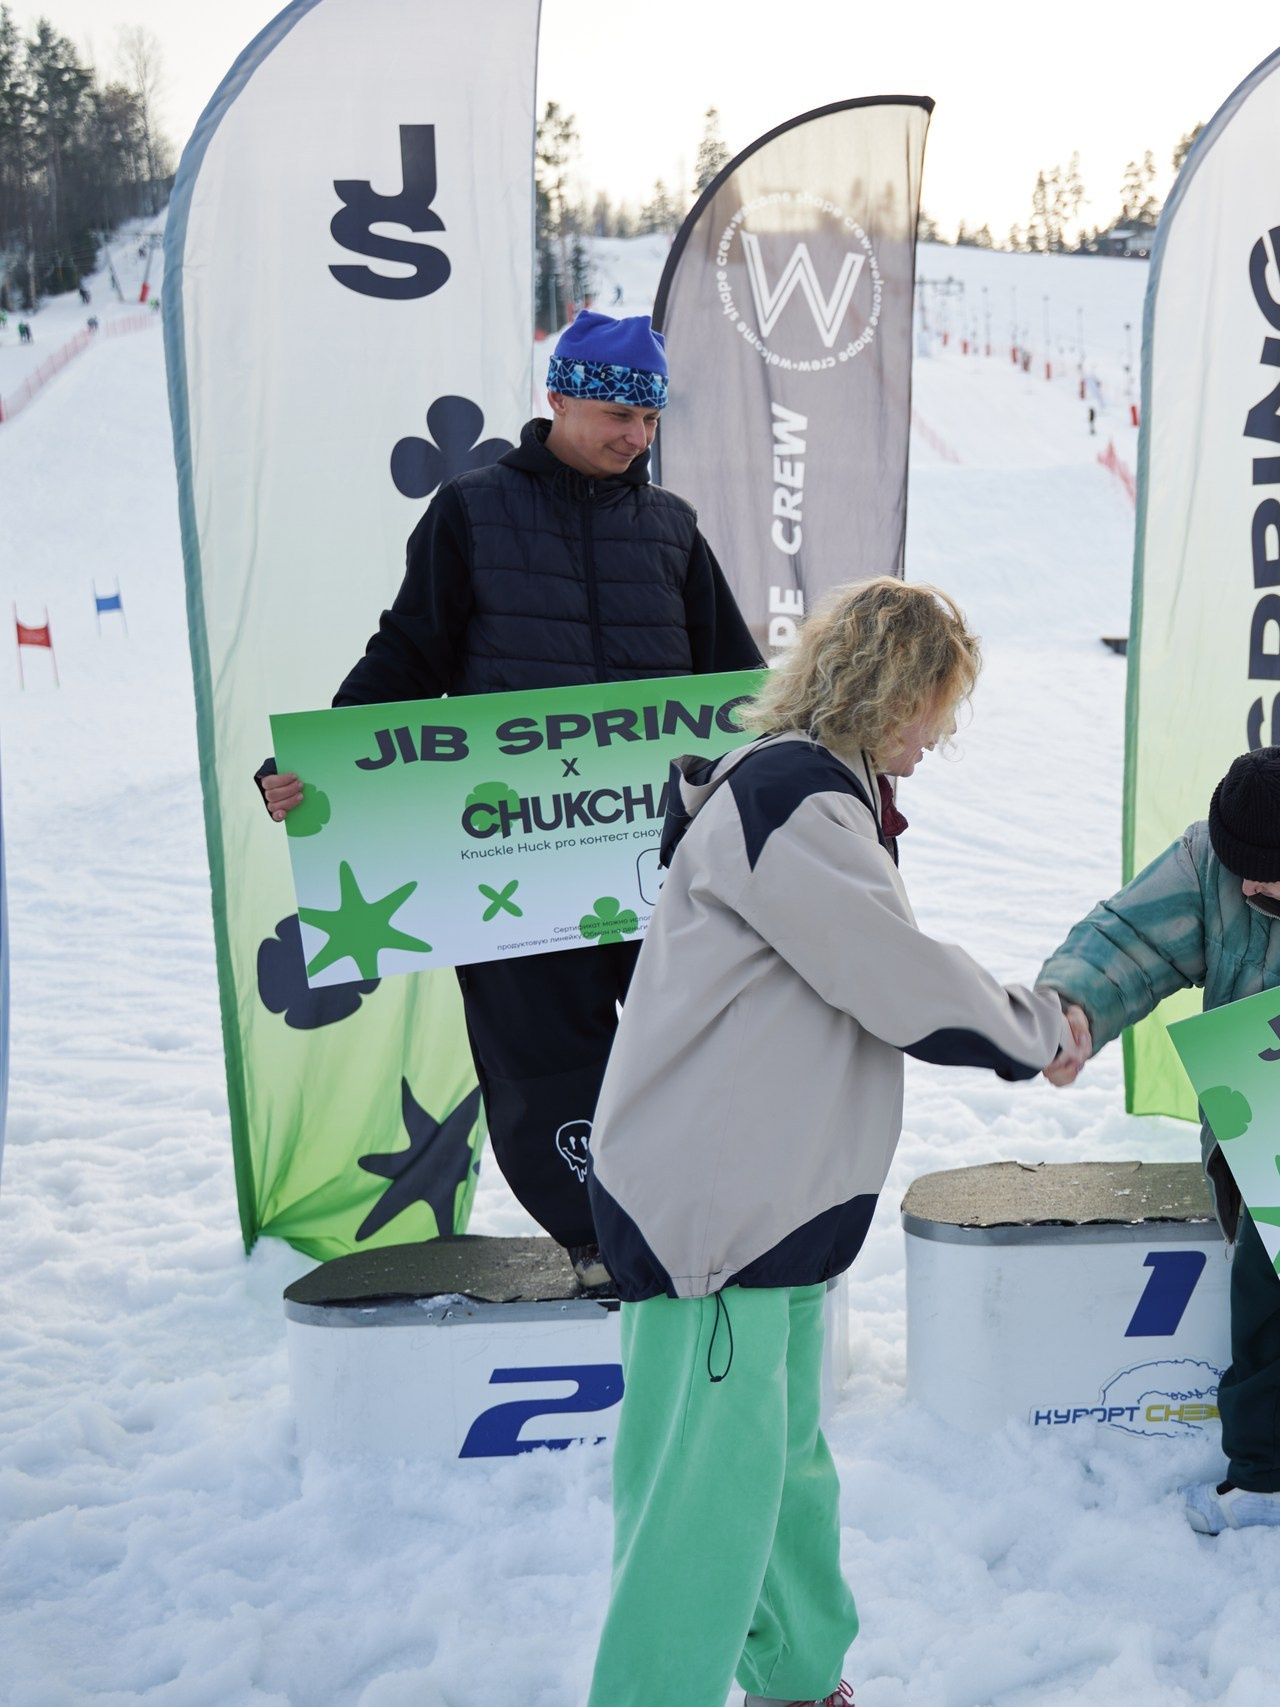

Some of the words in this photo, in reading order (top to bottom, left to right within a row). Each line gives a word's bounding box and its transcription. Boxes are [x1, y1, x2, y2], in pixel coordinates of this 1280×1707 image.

[716, 226, 735, 267] crew
[844, 217, 872, 250] crew
[771, 402, 808, 556] CREW
[354, 725, 469, 771] JIB
[461, 844, 514, 860] Knuckle
[518, 840, 551, 853] Huck
[555, 838, 576, 851] pro
[580, 832, 629, 845] контест
[497, 938, 548, 951] продуктовую
[550, 932, 581, 945] линейку
[553, 920, 601, 934] Сертификат
[602, 917, 629, 929] можно
[1125, 1250, 1207, 1337] 1
[458, 1363, 625, 1458] 2
